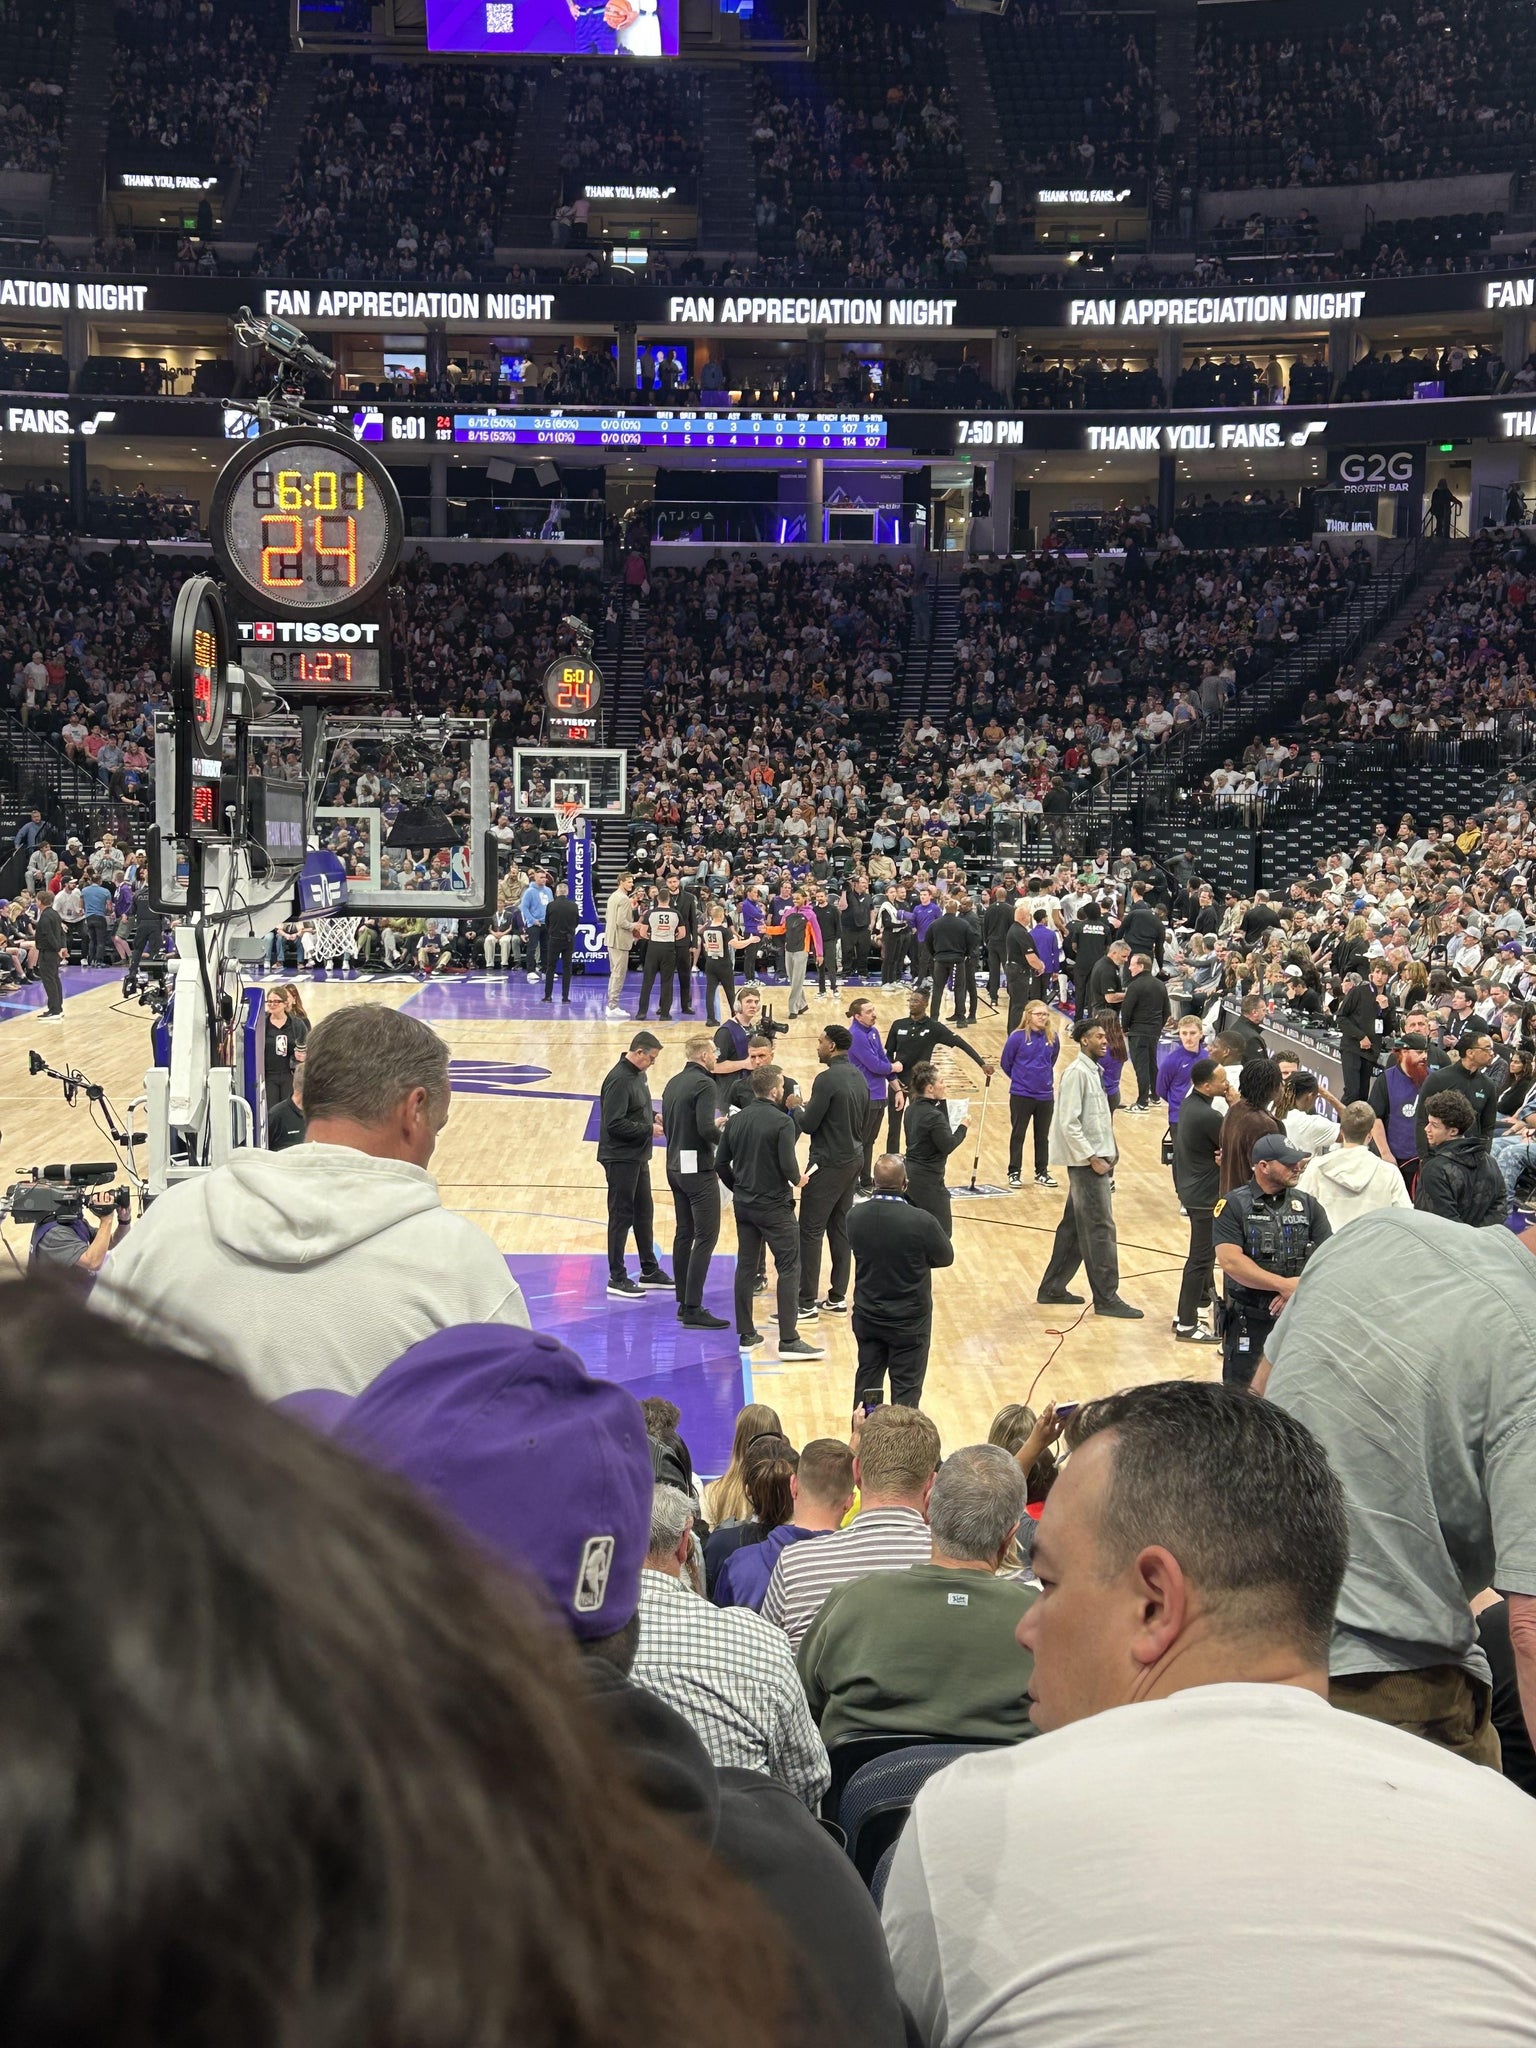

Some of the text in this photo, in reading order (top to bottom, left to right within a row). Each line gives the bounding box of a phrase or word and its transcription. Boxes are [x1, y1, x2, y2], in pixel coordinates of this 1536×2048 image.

[123, 174, 202, 189] THANK YOU, FANS.
[585, 186, 661, 199] THANK YOU, FANS.
[1039, 190, 1115, 203] THANK YOU, FANS.
[77, 284, 148, 311] NIGHT
[1487, 279, 1534, 308] FAN
[265, 290, 554, 320] FAN APPRECIATION NIGHT
[670, 297, 957, 326] FAN APPRECIATION NIGHT
[1071, 292, 1366, 325] FAN APPRECIATION NIGHT
[9, 408, 75, 434] FANS.
[391, 416, 426, 440] 6:01
[437, 416, 450, 428] 24
[468, 418, 879, 433] 6/12 (50%) 3/5 (60%) 0/0 (0%) 0 6 6 3 0 0 2 0 107 114
[436, 430, 452, 440] 1ST
[468, 430, 880, 446] 8/15 (53%) 0/1 (0%) 0/0 (0%) 1 5 6 4 1 0 0 0 114 107
[959, 421, 1023, 443] 7:50 PM
[1088, 426, 1160, 450] THANK
[1222, 423, 1285, 448] FANS.
[1340, 452, 1413, 482] G2G
[277, 471, 364, 510] 6:01
[1344, 483, 1409, 493] PROTEIN BAR
[261, 514, 357, 587] 24
[277, 623, 379, 643] TISSOT
[300, 653, 352, 681] 1:27
[563, 668, 594, 684] 6:01
[557, 683, 590, 709] 24
[563, 718, 597, 727] TISSOT
[568, 728, 588, 739] 1:27
[575, 841, 584, 917] AMERICA FIRST
[659, 914, 670, 924] 53
[328, 974, 509, 983] JAZZ
[1282, 1215, 1309, 1225] POLICE
